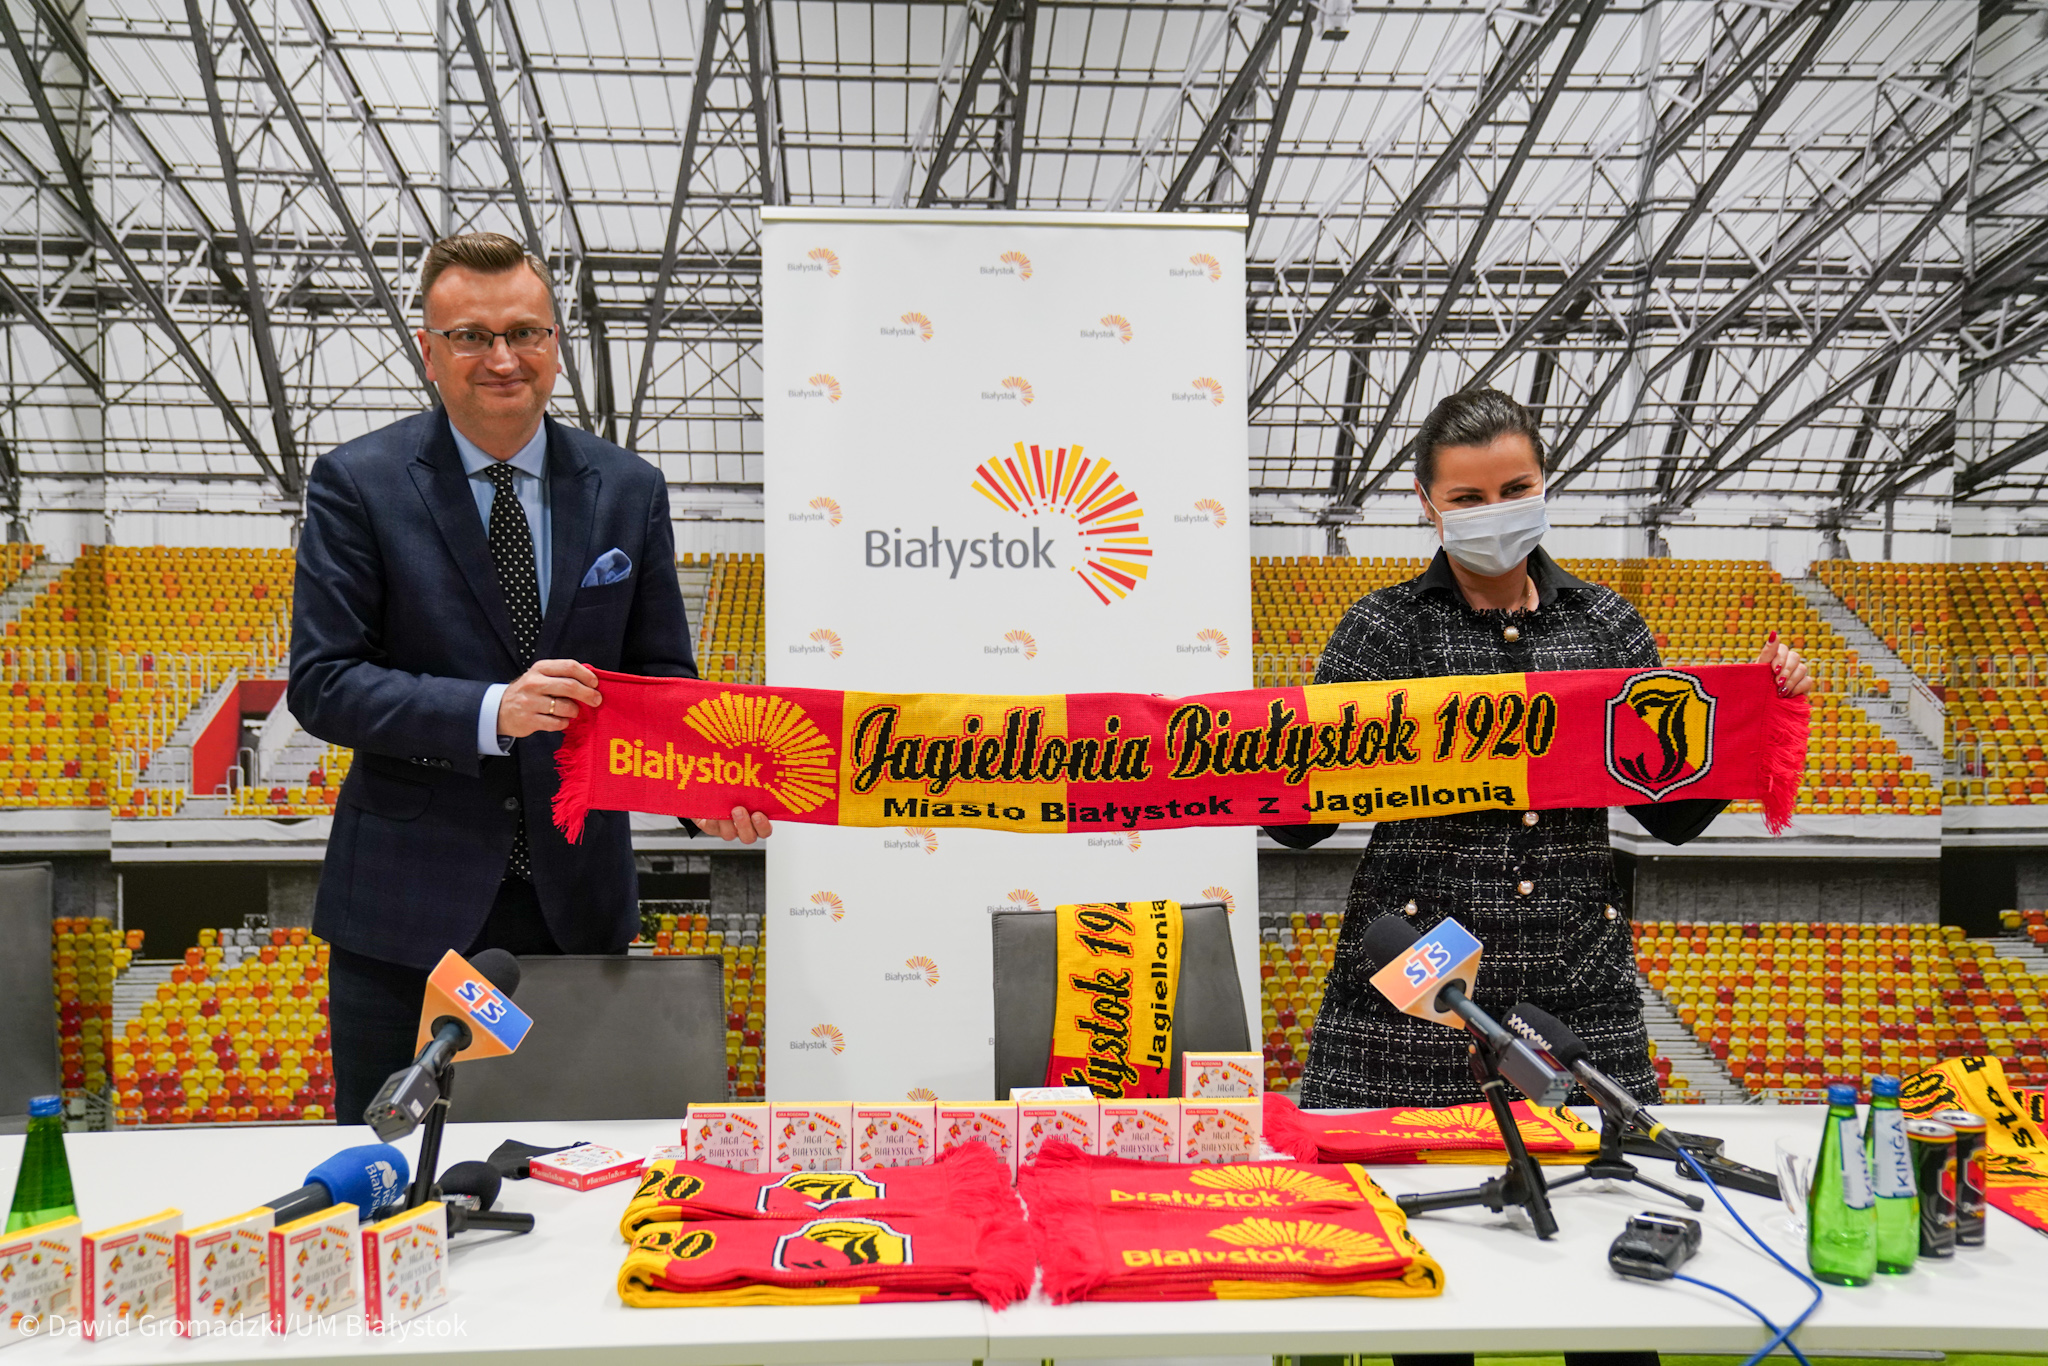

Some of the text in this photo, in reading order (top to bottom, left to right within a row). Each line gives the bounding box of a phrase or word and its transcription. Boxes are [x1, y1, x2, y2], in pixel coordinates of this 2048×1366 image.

[787, 261, 824, 274] Białystok
[980, 264, 1015, 276] Białystok
[1169, 267, 1204, 279] Białystok
[880, 325, 916, 338] Białystok
[1080, 327, 1115, 340] Białystok
[788, 387, 824, 400] Białystok
[981, 389, 1017, 402] Białystok
[1171, 391, 1207, 403] Białystok
[788, 511, 825, 524] Białystok
[1174, 513, 1210, 525] Białystok
[864, 525, 1057, 580] Białystok
[789, 643, 826, 656] Białystok
[984, 643, 1020, 656] Białystok
[1176, 642, 1212, 655] Białystok
[852, 690, 1556, 796] Jagiellonia Białystok 1920
[609, 737, 764, 790] Białystok
[884, 797, 1025, 822] Miasto
[1041, 795, 1233, 828] Białystok
[1302, 781, 1515, 816] Jagiellonią
[884, 838, 921, 851] Białystok
[1088, 836, 1125, 849] Białystok
[789, 905, 827, 918] Białystok
[1403, 941, 1451, 988] STS
[884, 970, 922, 983] Białystok
[455, 979, 507, 1024] STS
[790, 1039, 828, 1052] Białystok
[634, 1170, 703, 1199] 20
